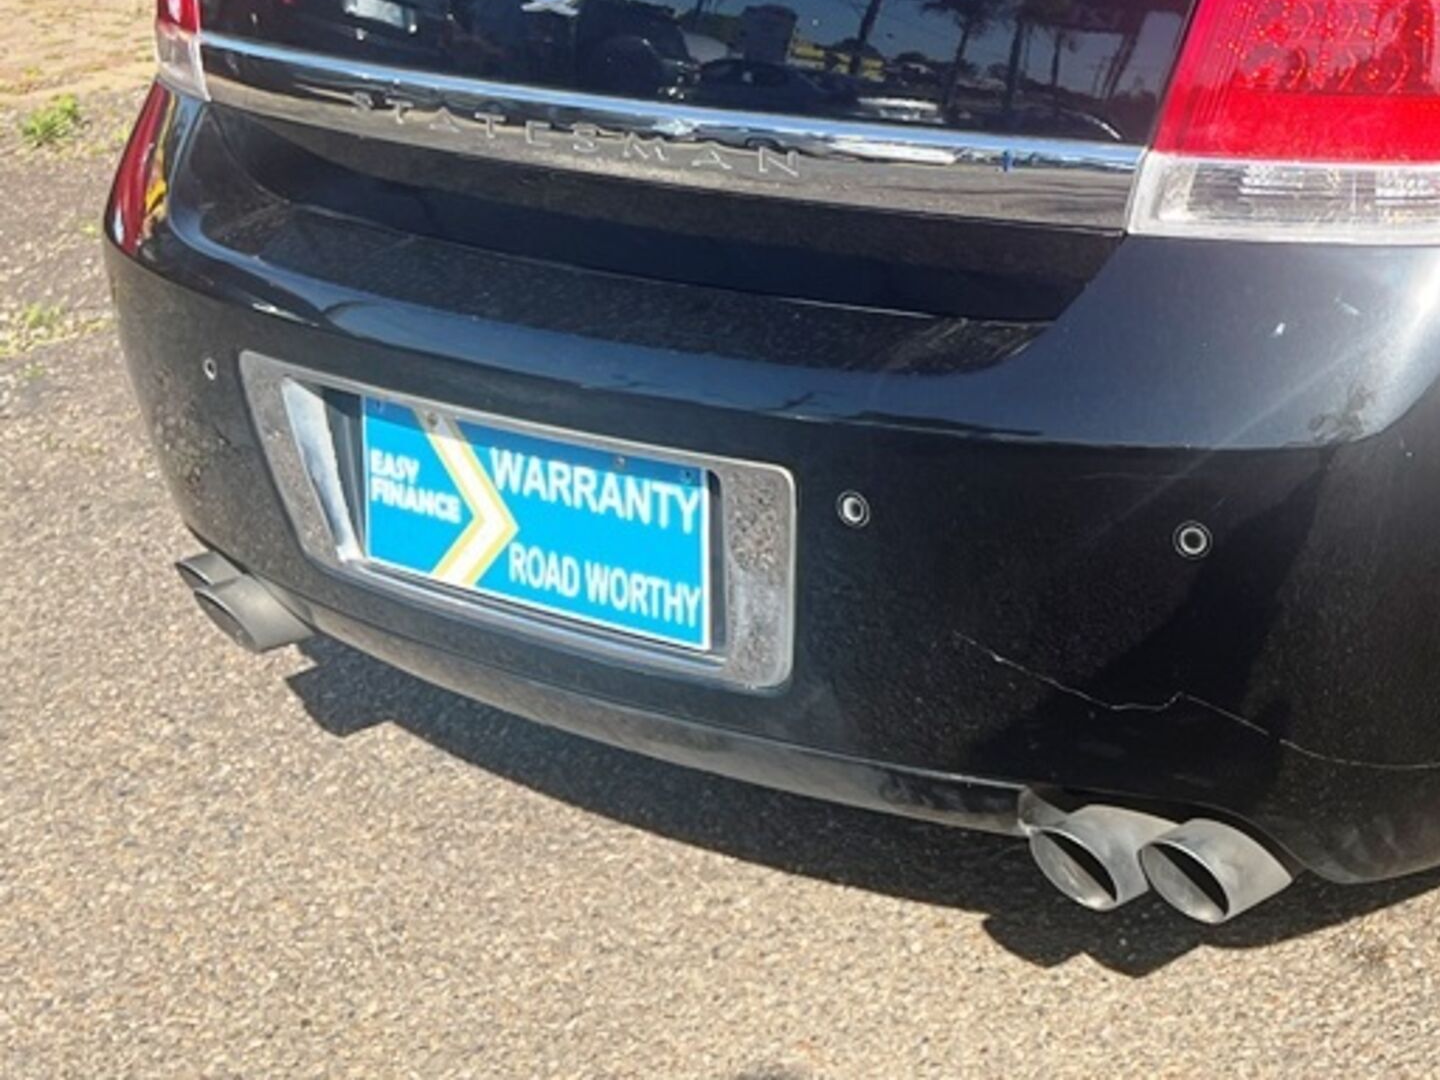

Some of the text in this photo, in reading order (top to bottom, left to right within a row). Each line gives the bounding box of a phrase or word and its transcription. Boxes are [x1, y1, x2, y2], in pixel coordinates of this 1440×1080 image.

[350, 90, 799, 177] STATESMAN
[370, 448, 420, 484] EASY
[370, 476, 462, 525] FINANCE
[489, 446, 701, 535] WARRANTY
[508, 541, 701, 629] ROAD WORTHY
